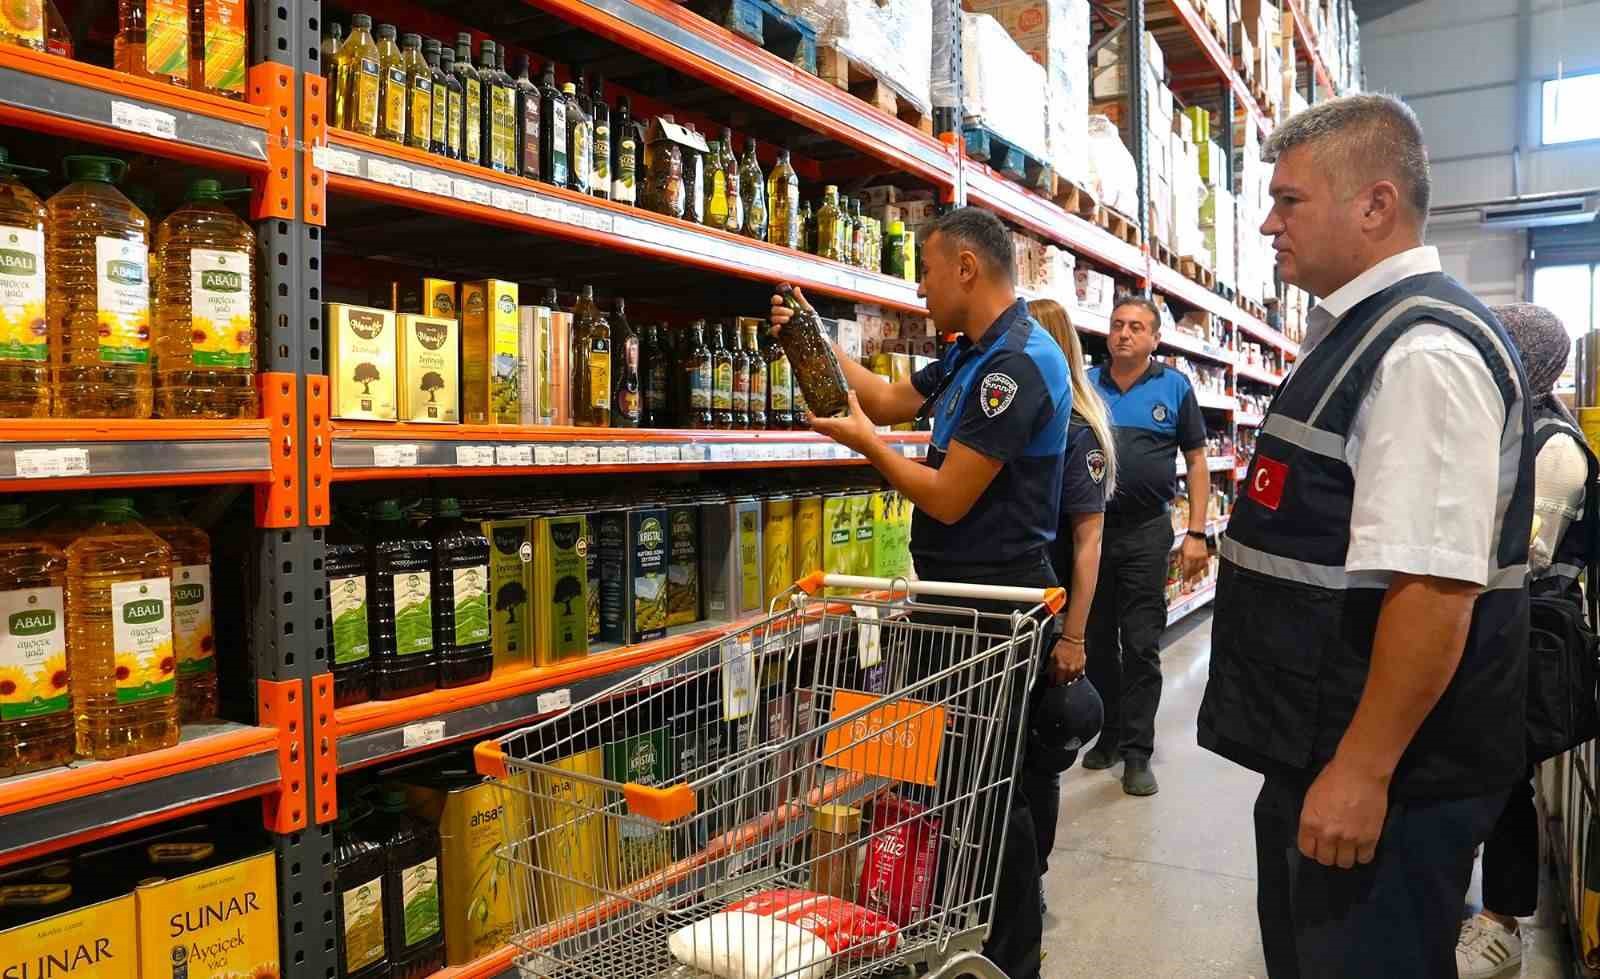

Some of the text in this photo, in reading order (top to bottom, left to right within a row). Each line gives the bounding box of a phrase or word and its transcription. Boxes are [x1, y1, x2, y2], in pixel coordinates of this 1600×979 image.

[206, 274, 239, 289] ABALI
[127, 604, 161, 618] ABALI
[15, 615, 51, 629] ABALI
[169, 891, 261, 938] SUNAR
[189, 928, 246, 964] Ayçiçek
